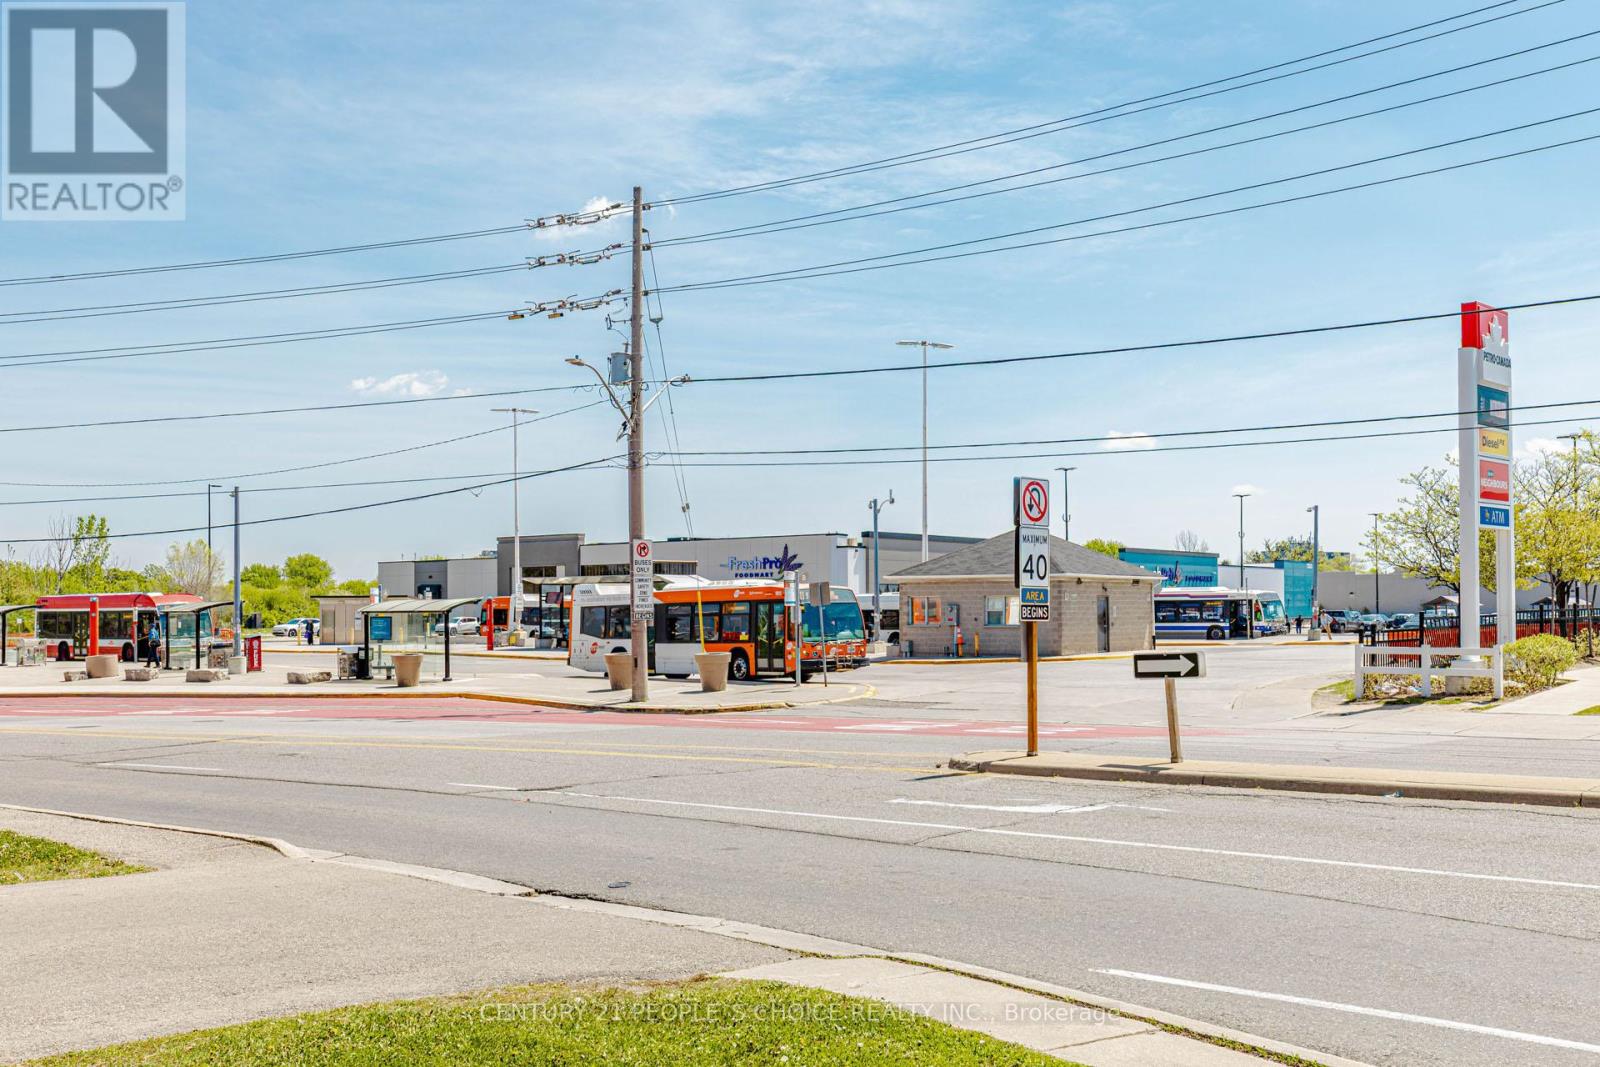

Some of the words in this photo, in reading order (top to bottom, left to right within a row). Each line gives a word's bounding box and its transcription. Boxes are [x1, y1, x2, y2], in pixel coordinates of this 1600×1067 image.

[1491, 510, 1505, 523] ATM
[1022, 534, 1047, 544] MAXIMUM
[1023, 554, 1047, 580] 40
[1026, 592, 1044, 601] AREA
[1022, 606, 1048, 619] BEGINS
